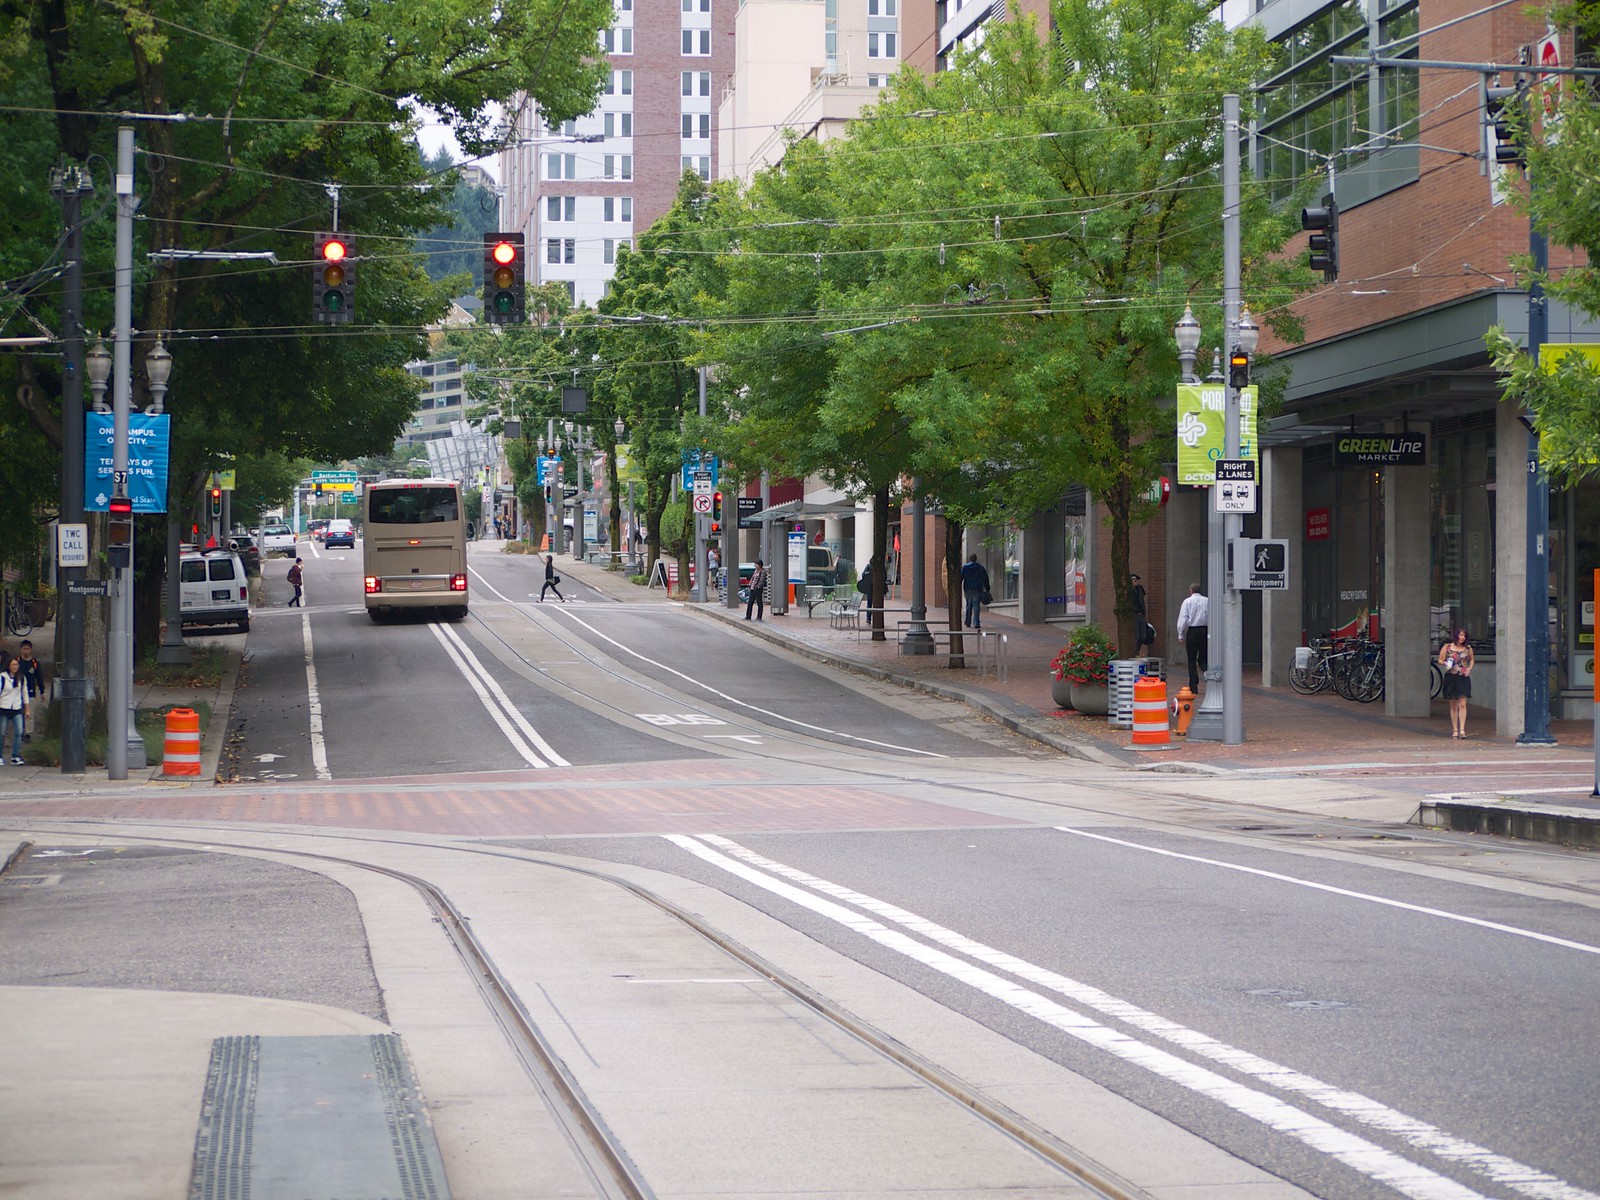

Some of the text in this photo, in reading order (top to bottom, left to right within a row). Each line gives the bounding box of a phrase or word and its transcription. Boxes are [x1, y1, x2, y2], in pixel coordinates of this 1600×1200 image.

[1338, 438, 1422, 453] GREENLine
[141, 459, 154, 467] OF
[135, 467, 155, 476] FUN.
[114, 472, 127, 483] S7
[65, 529, 81, 538] TWC
[63, 541, 83, 550] CALL
[69, 586, 105, 595] Montgomery
[635, 713, 728, 726] BUS
